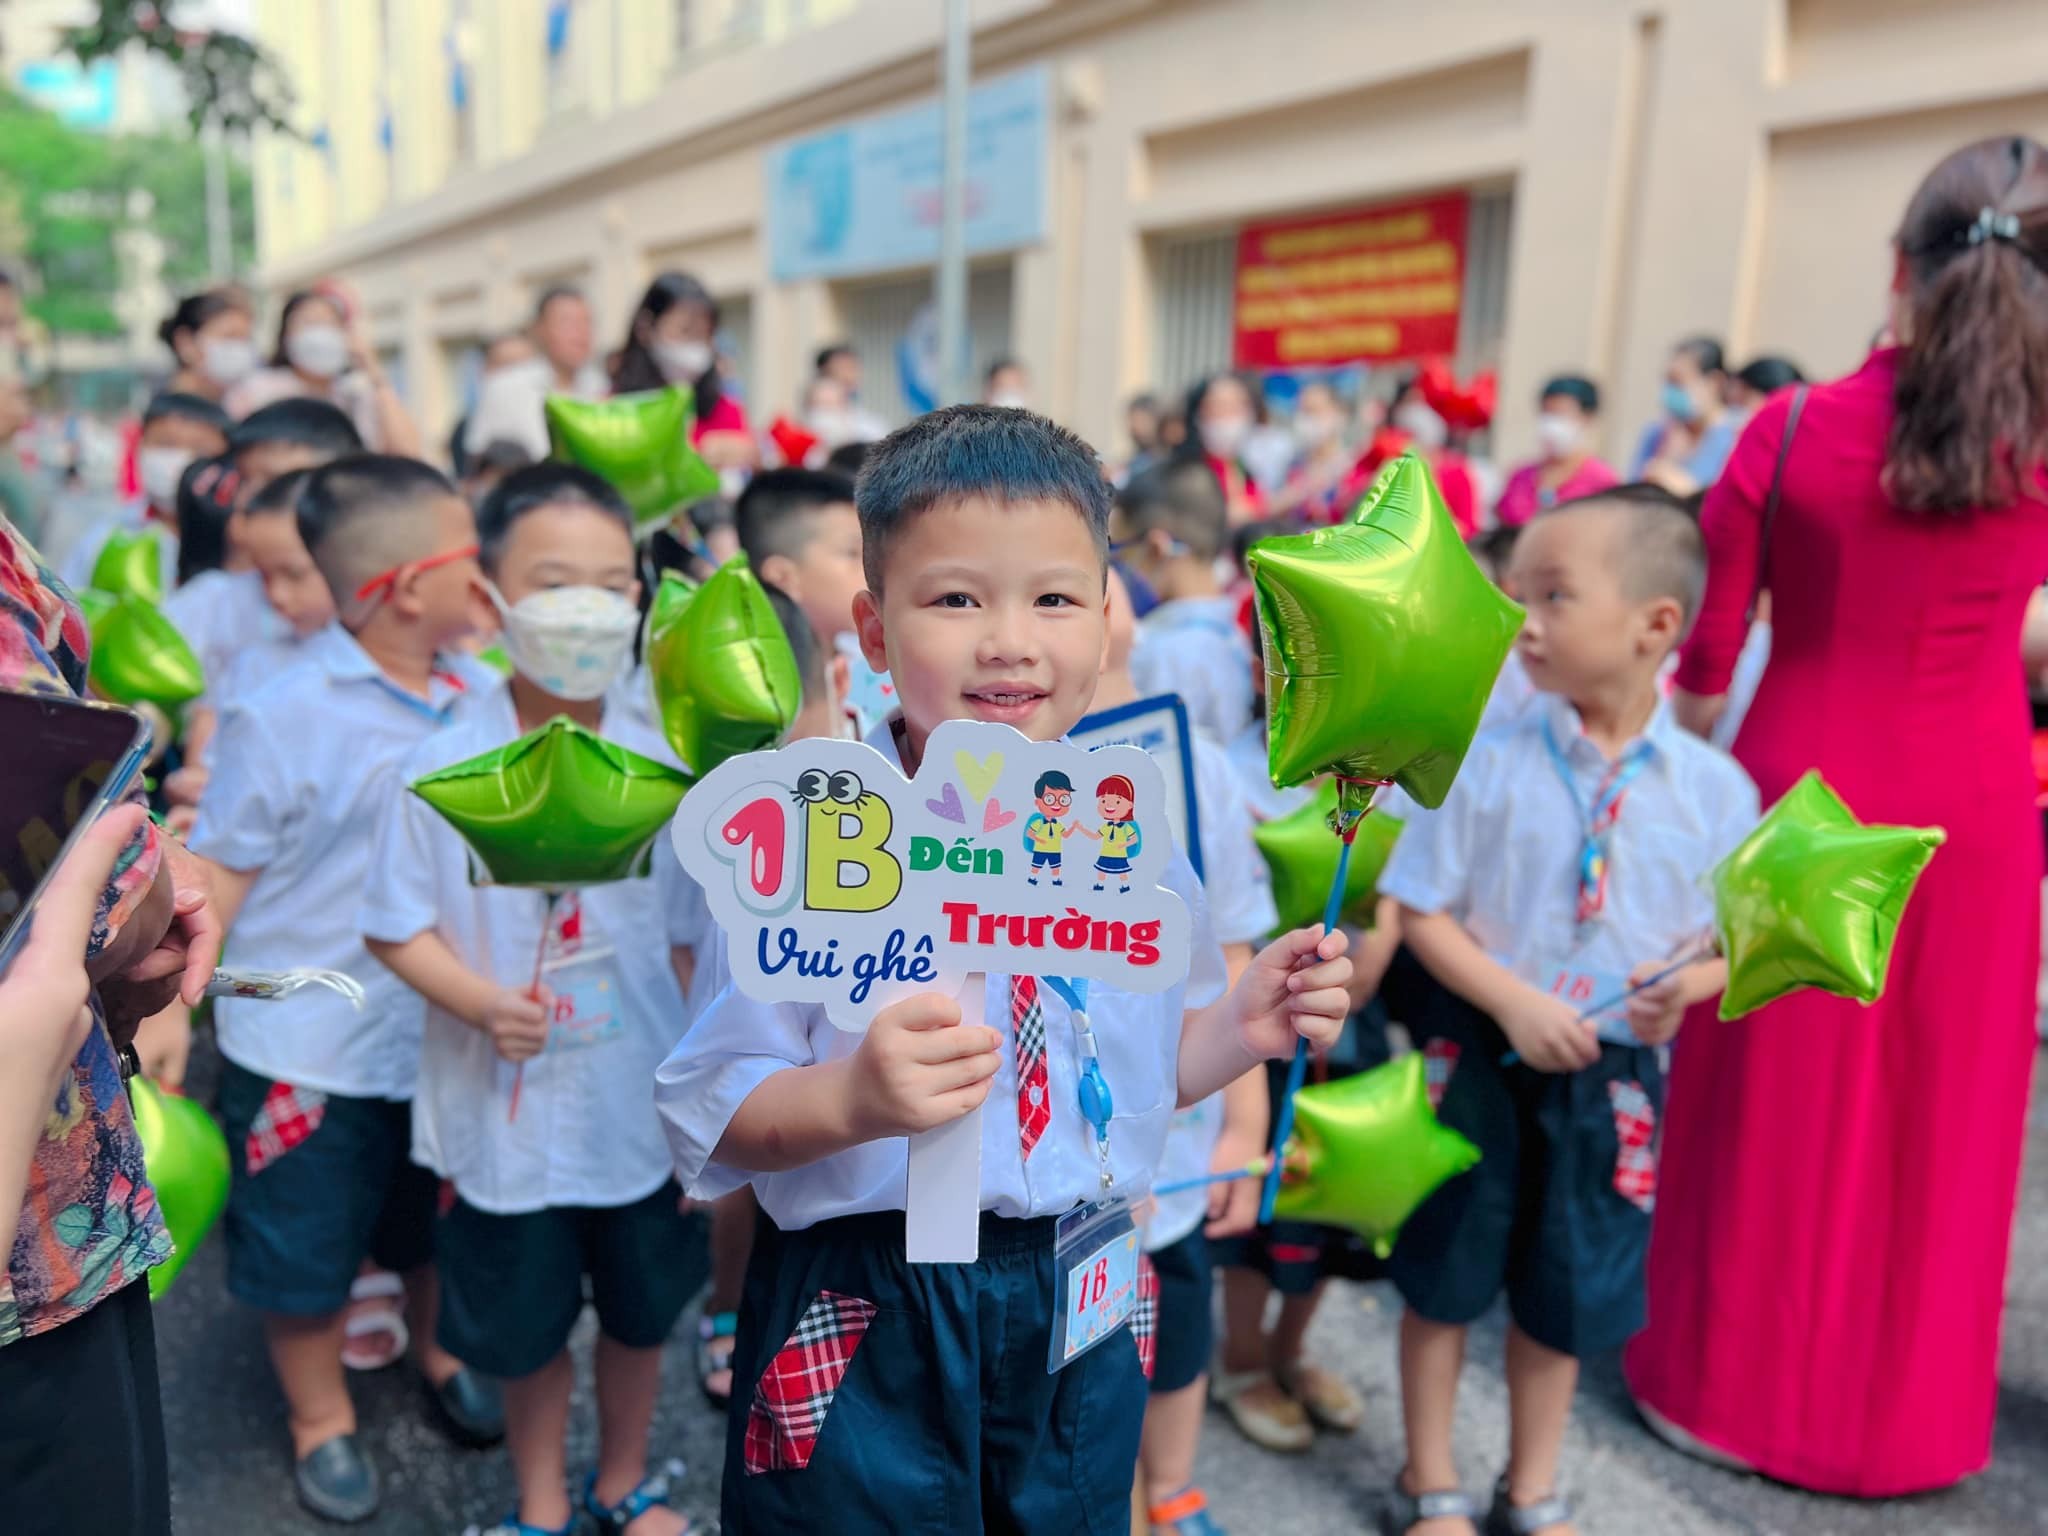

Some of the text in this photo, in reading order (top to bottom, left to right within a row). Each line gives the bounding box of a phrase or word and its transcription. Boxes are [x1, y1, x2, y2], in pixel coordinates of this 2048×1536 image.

[715, 786, 903, 914] 1B
[908, 836, 1004, 875] Đến
[757, 927, 938, 1004] Vui ghê
[942, 901, 1161, 966] Trường
[1078, 1256, 1108, 1315] 1B
